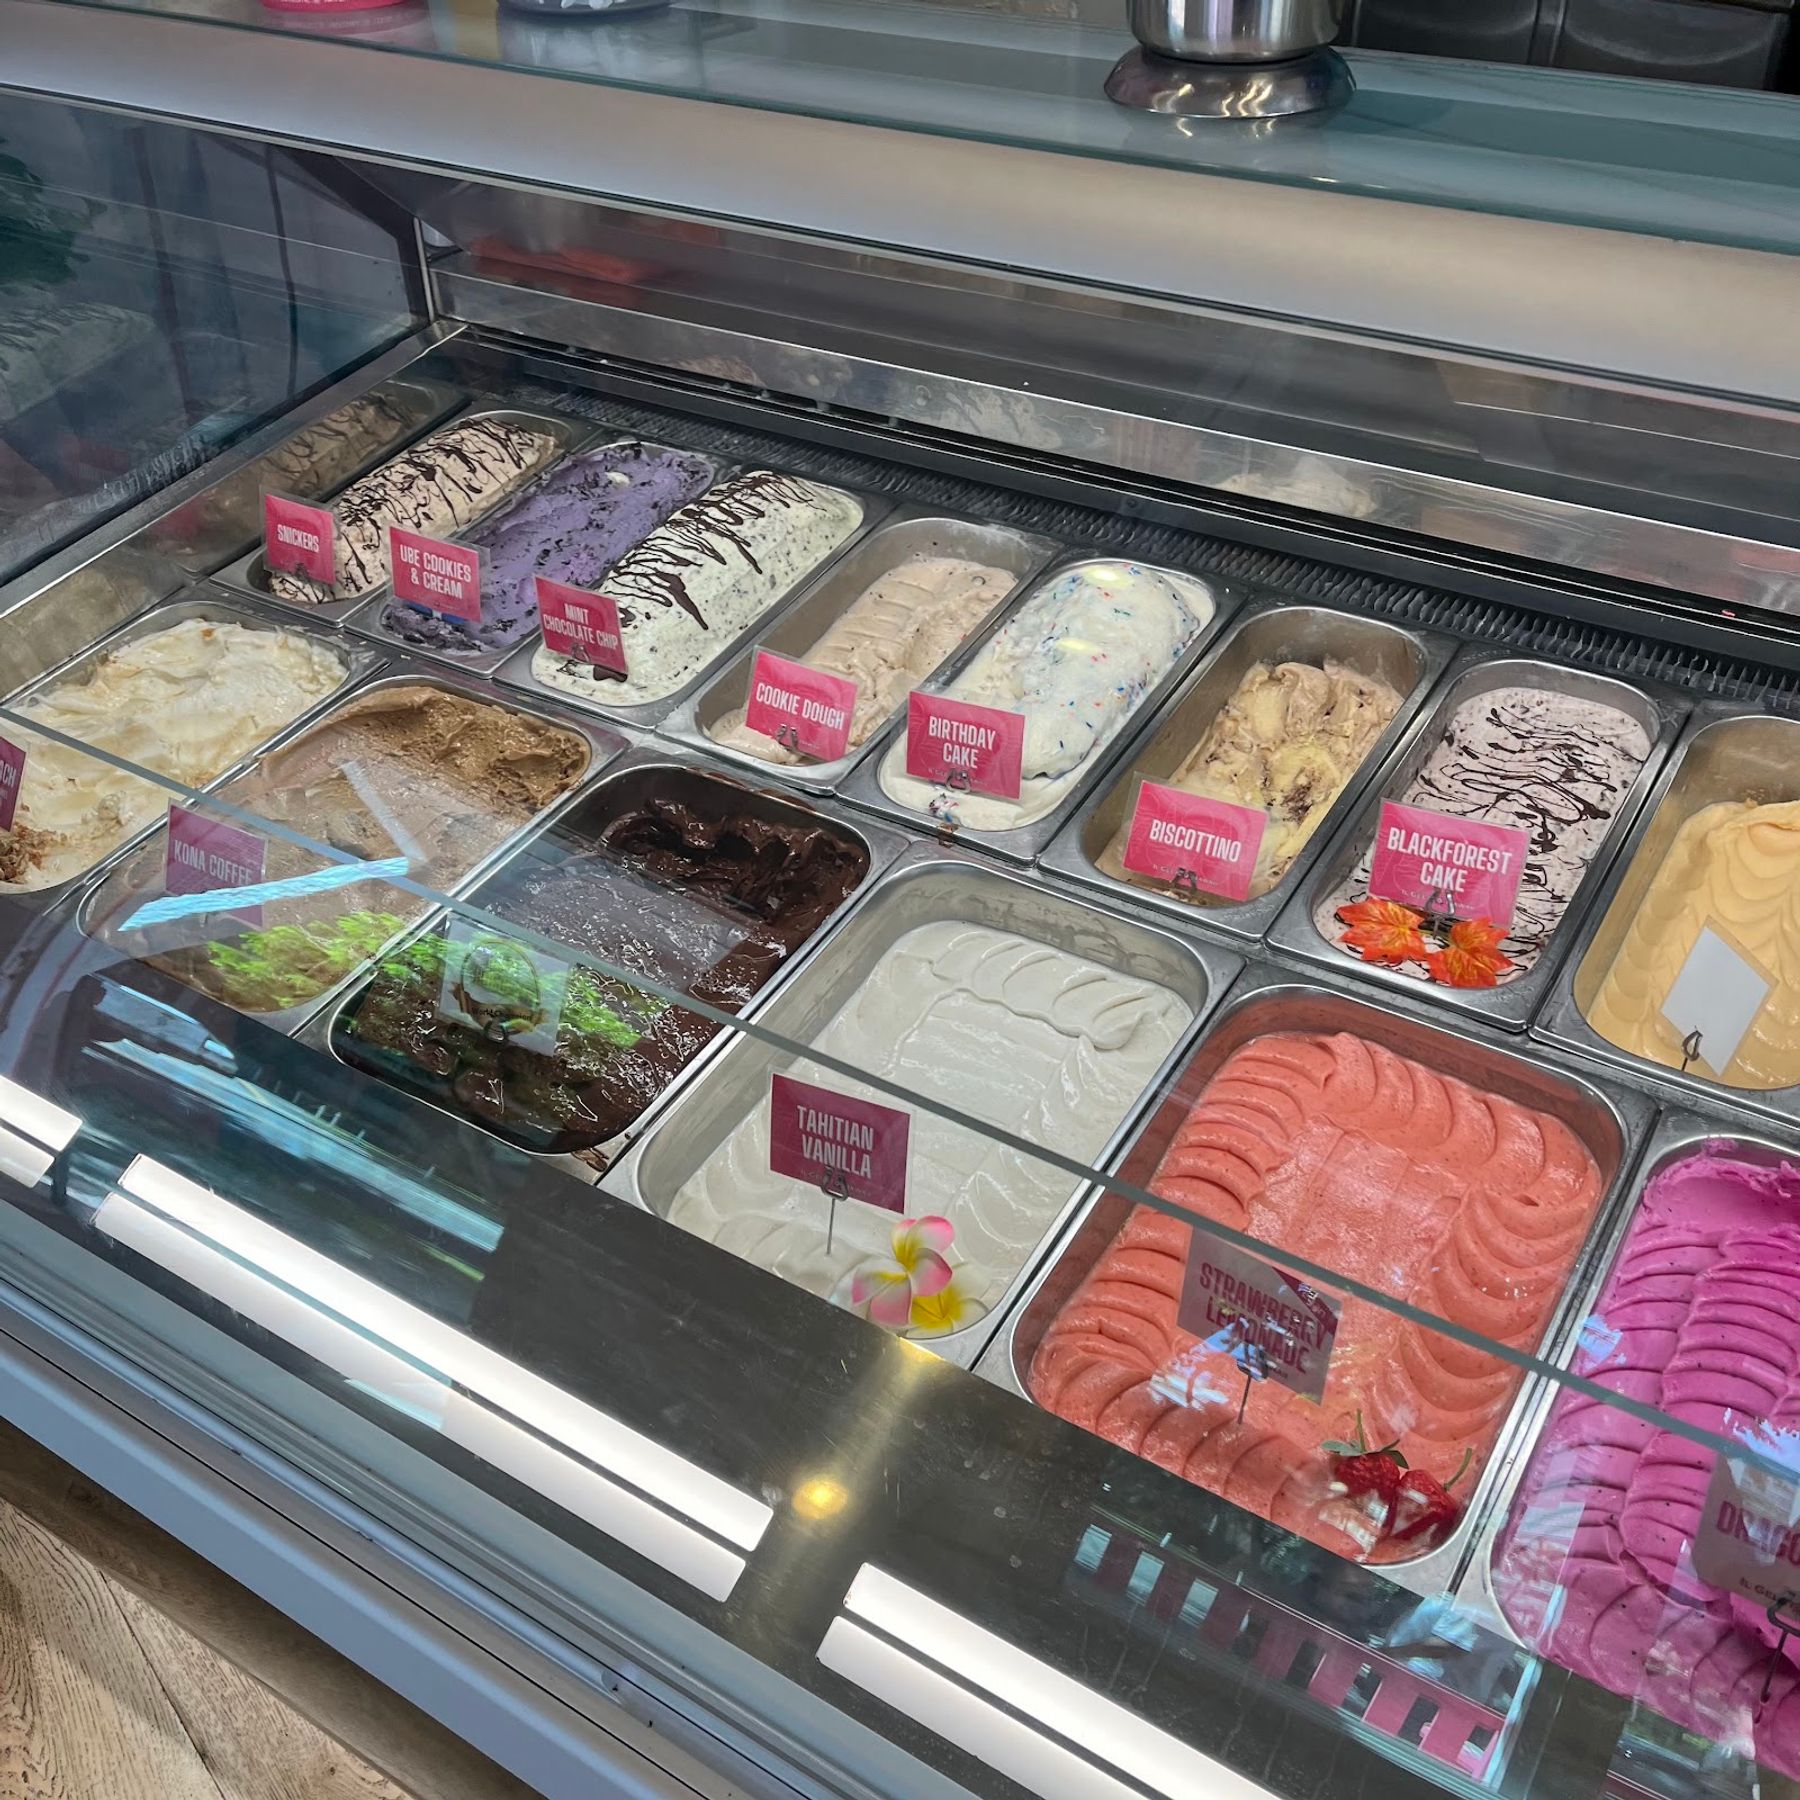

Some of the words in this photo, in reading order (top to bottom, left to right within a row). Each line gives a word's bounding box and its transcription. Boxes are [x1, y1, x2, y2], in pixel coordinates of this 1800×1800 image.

[277, 524, 320, 553] SNICKERS
[400, 544, 420, 568] UBE
[424, 552, 472, 583] COOKIES
[410, 567, 420, 585] &
[423, 573, 463, 599] CREAM
[543, 613, 596, 645] CHOCOLATE
[596, 629, 618, 650] CHIP
[564, 603, 589, 626] MINT
[756, 682, 800, 716] COOKIE
[802, 698, 845, 731] DOUGH
[928, 715, 996, 750] BIRTHDAY
[942, 743, 978, 769] CAKE
[1149, 819, 1242, 862] BISCOTTINO
[1387, 826, 1513, 875] BLACKFOREST
[174, 839, 206, 873] KONA
[209, 854, 253, 885] COFFEE
[1420, 861, 1469, 892] CAKE
[797, 1104, 874, 1151] TAHITIAN
[802, 1133, 871, 1179] VANILLA
[1200, 1261, 1329, 1350] STRAWBERRY
